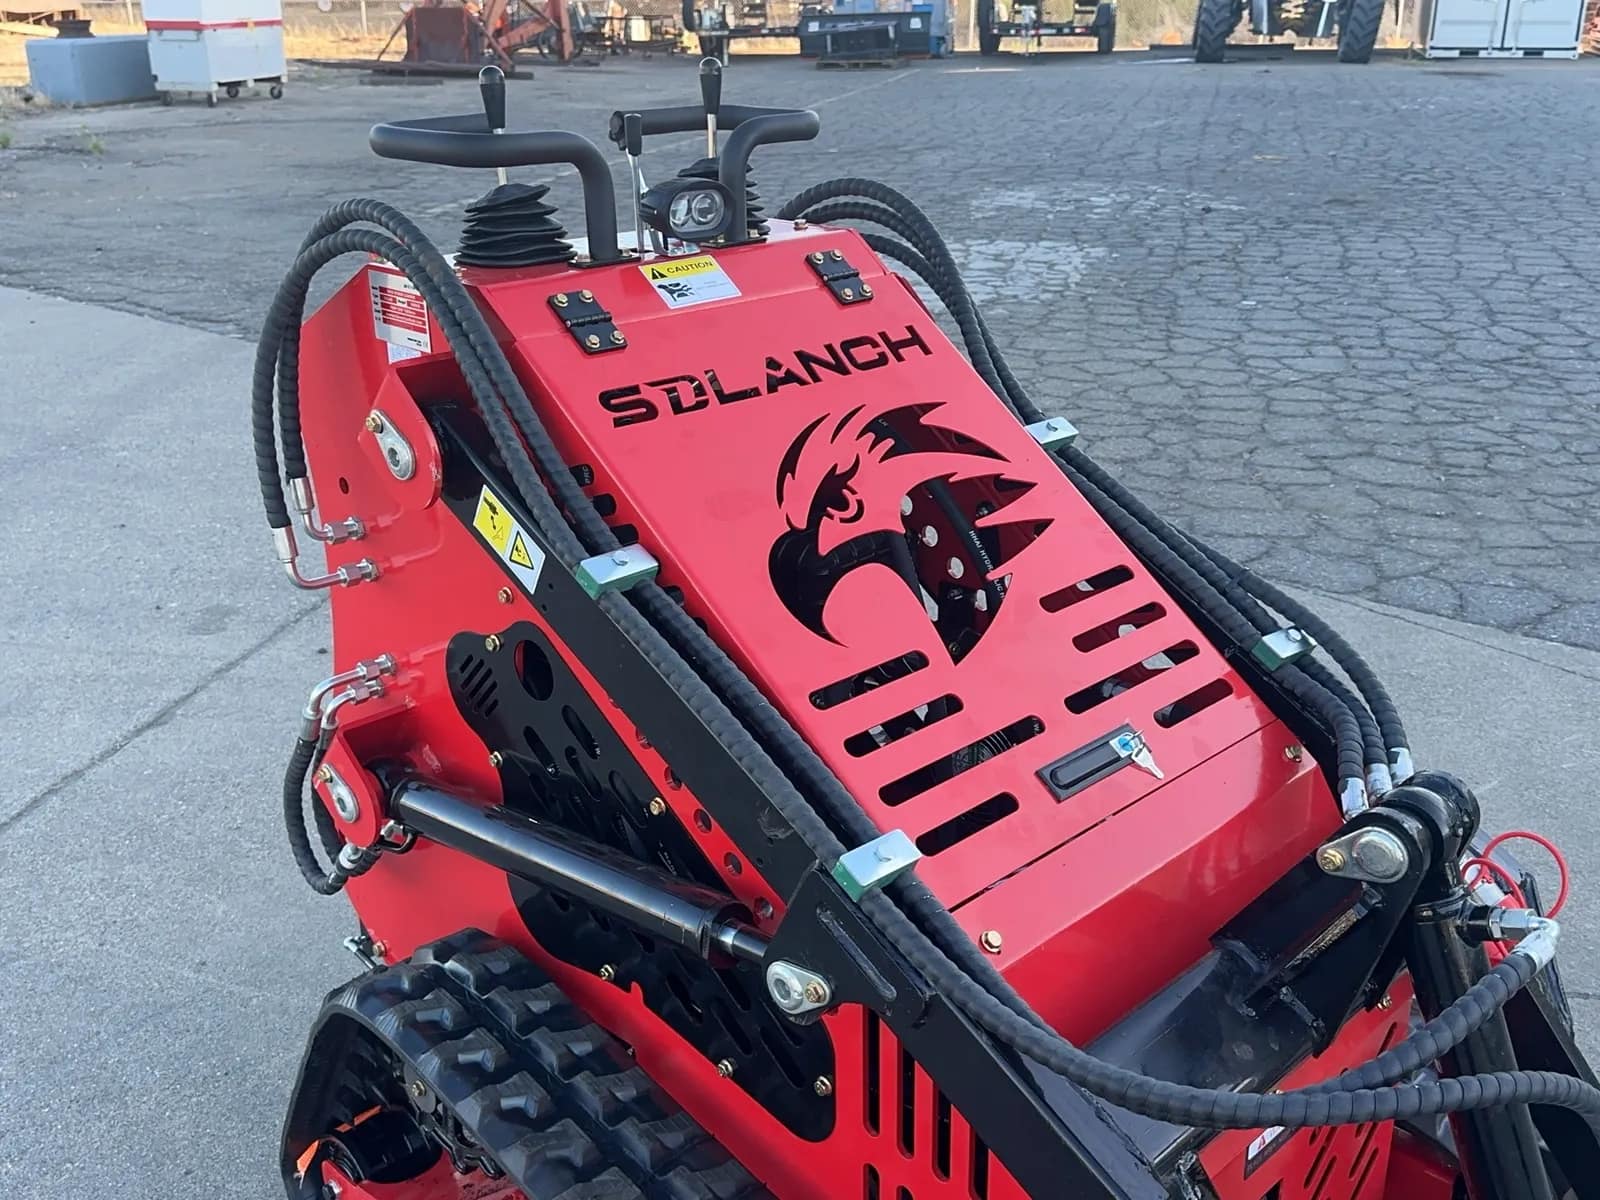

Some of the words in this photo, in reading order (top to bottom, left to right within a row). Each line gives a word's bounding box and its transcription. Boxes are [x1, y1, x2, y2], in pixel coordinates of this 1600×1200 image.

[666, 261, 713, 274] CAUTION
[598, 325, 933, 428] SDLANCH
[980, 549, 1004, 592] HYDRLIC
